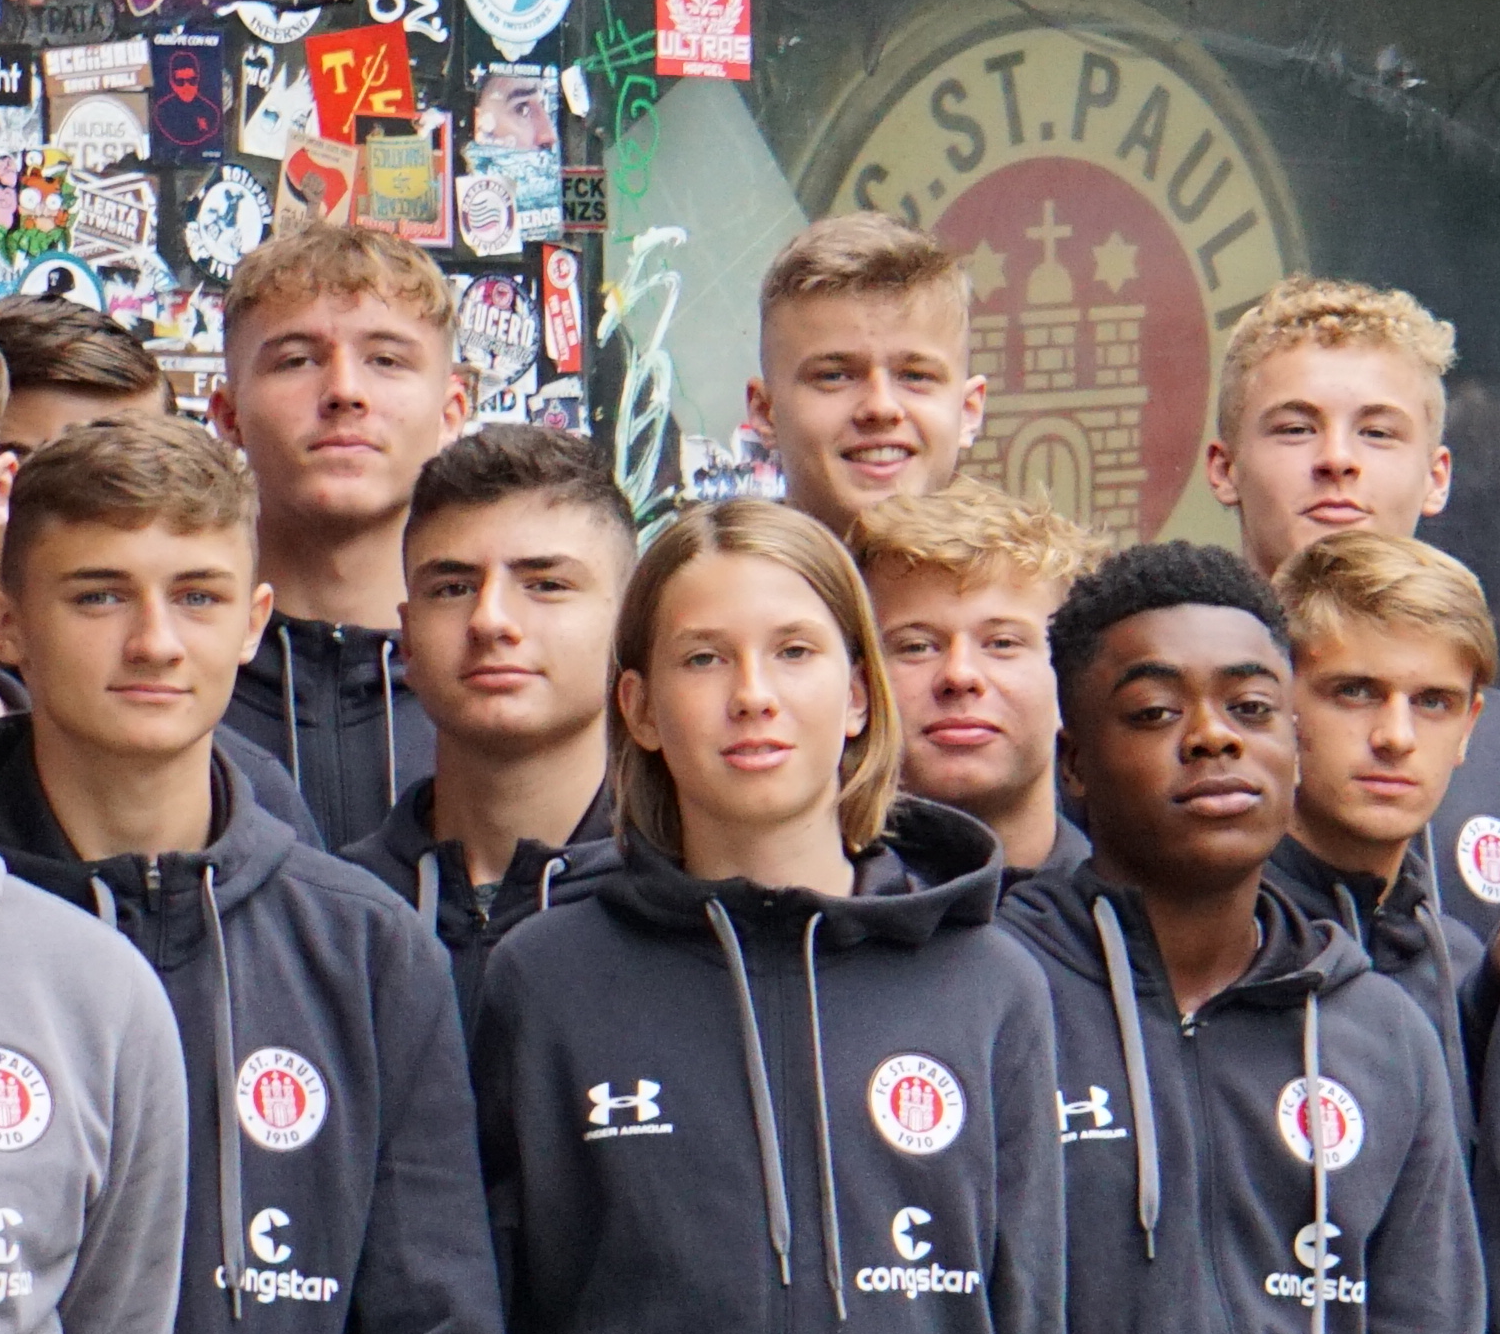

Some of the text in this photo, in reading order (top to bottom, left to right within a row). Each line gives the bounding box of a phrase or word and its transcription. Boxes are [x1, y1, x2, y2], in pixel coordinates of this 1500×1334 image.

[656, 30, 752, 64] ULTRAS
[930, 49, 1056, 173] ST.
[562, 177, 605, 200] FCK
[562, 200, 607, 222] NZS
[239, 1052, 322, 1097] FC ST. PAULI
[876, 1061, 964, 1108] FC ST. PAULI
[264, 1129, 302, 1143] 1910
[897, 1132, 935, 1149] 1910
[856, 1264, 980, 1300] congstar
